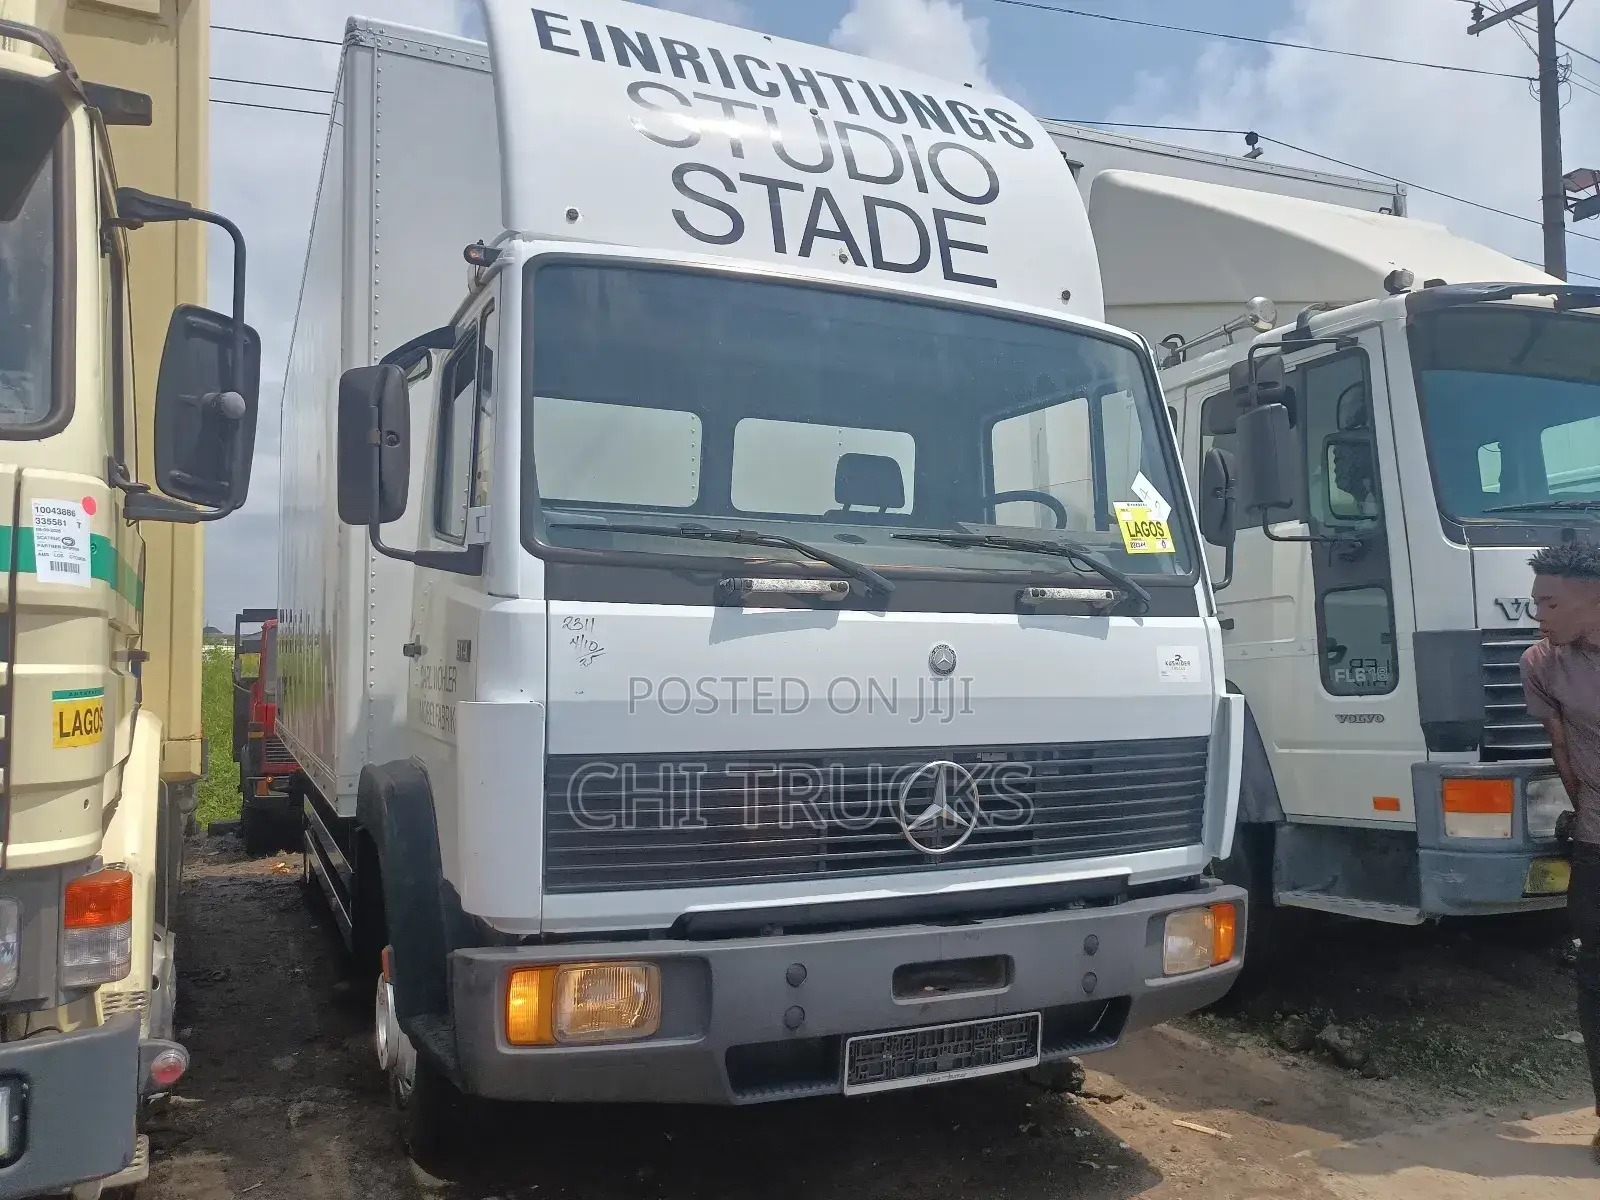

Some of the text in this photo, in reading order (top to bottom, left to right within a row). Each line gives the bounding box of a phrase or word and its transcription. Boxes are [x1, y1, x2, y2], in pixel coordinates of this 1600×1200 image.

[530, 8, 1034, 150] EINRICHTUNGS
[626, 80, 1000, 205] STUDIO
[671, 162, 997, 289] STADE
[76, 521, 82, 529] T
[1126, 521, 1165, 538] LAGOS
[59, 705, 104, 738] LAGOS
[1335, 713, 1385, 724] VOLVO
